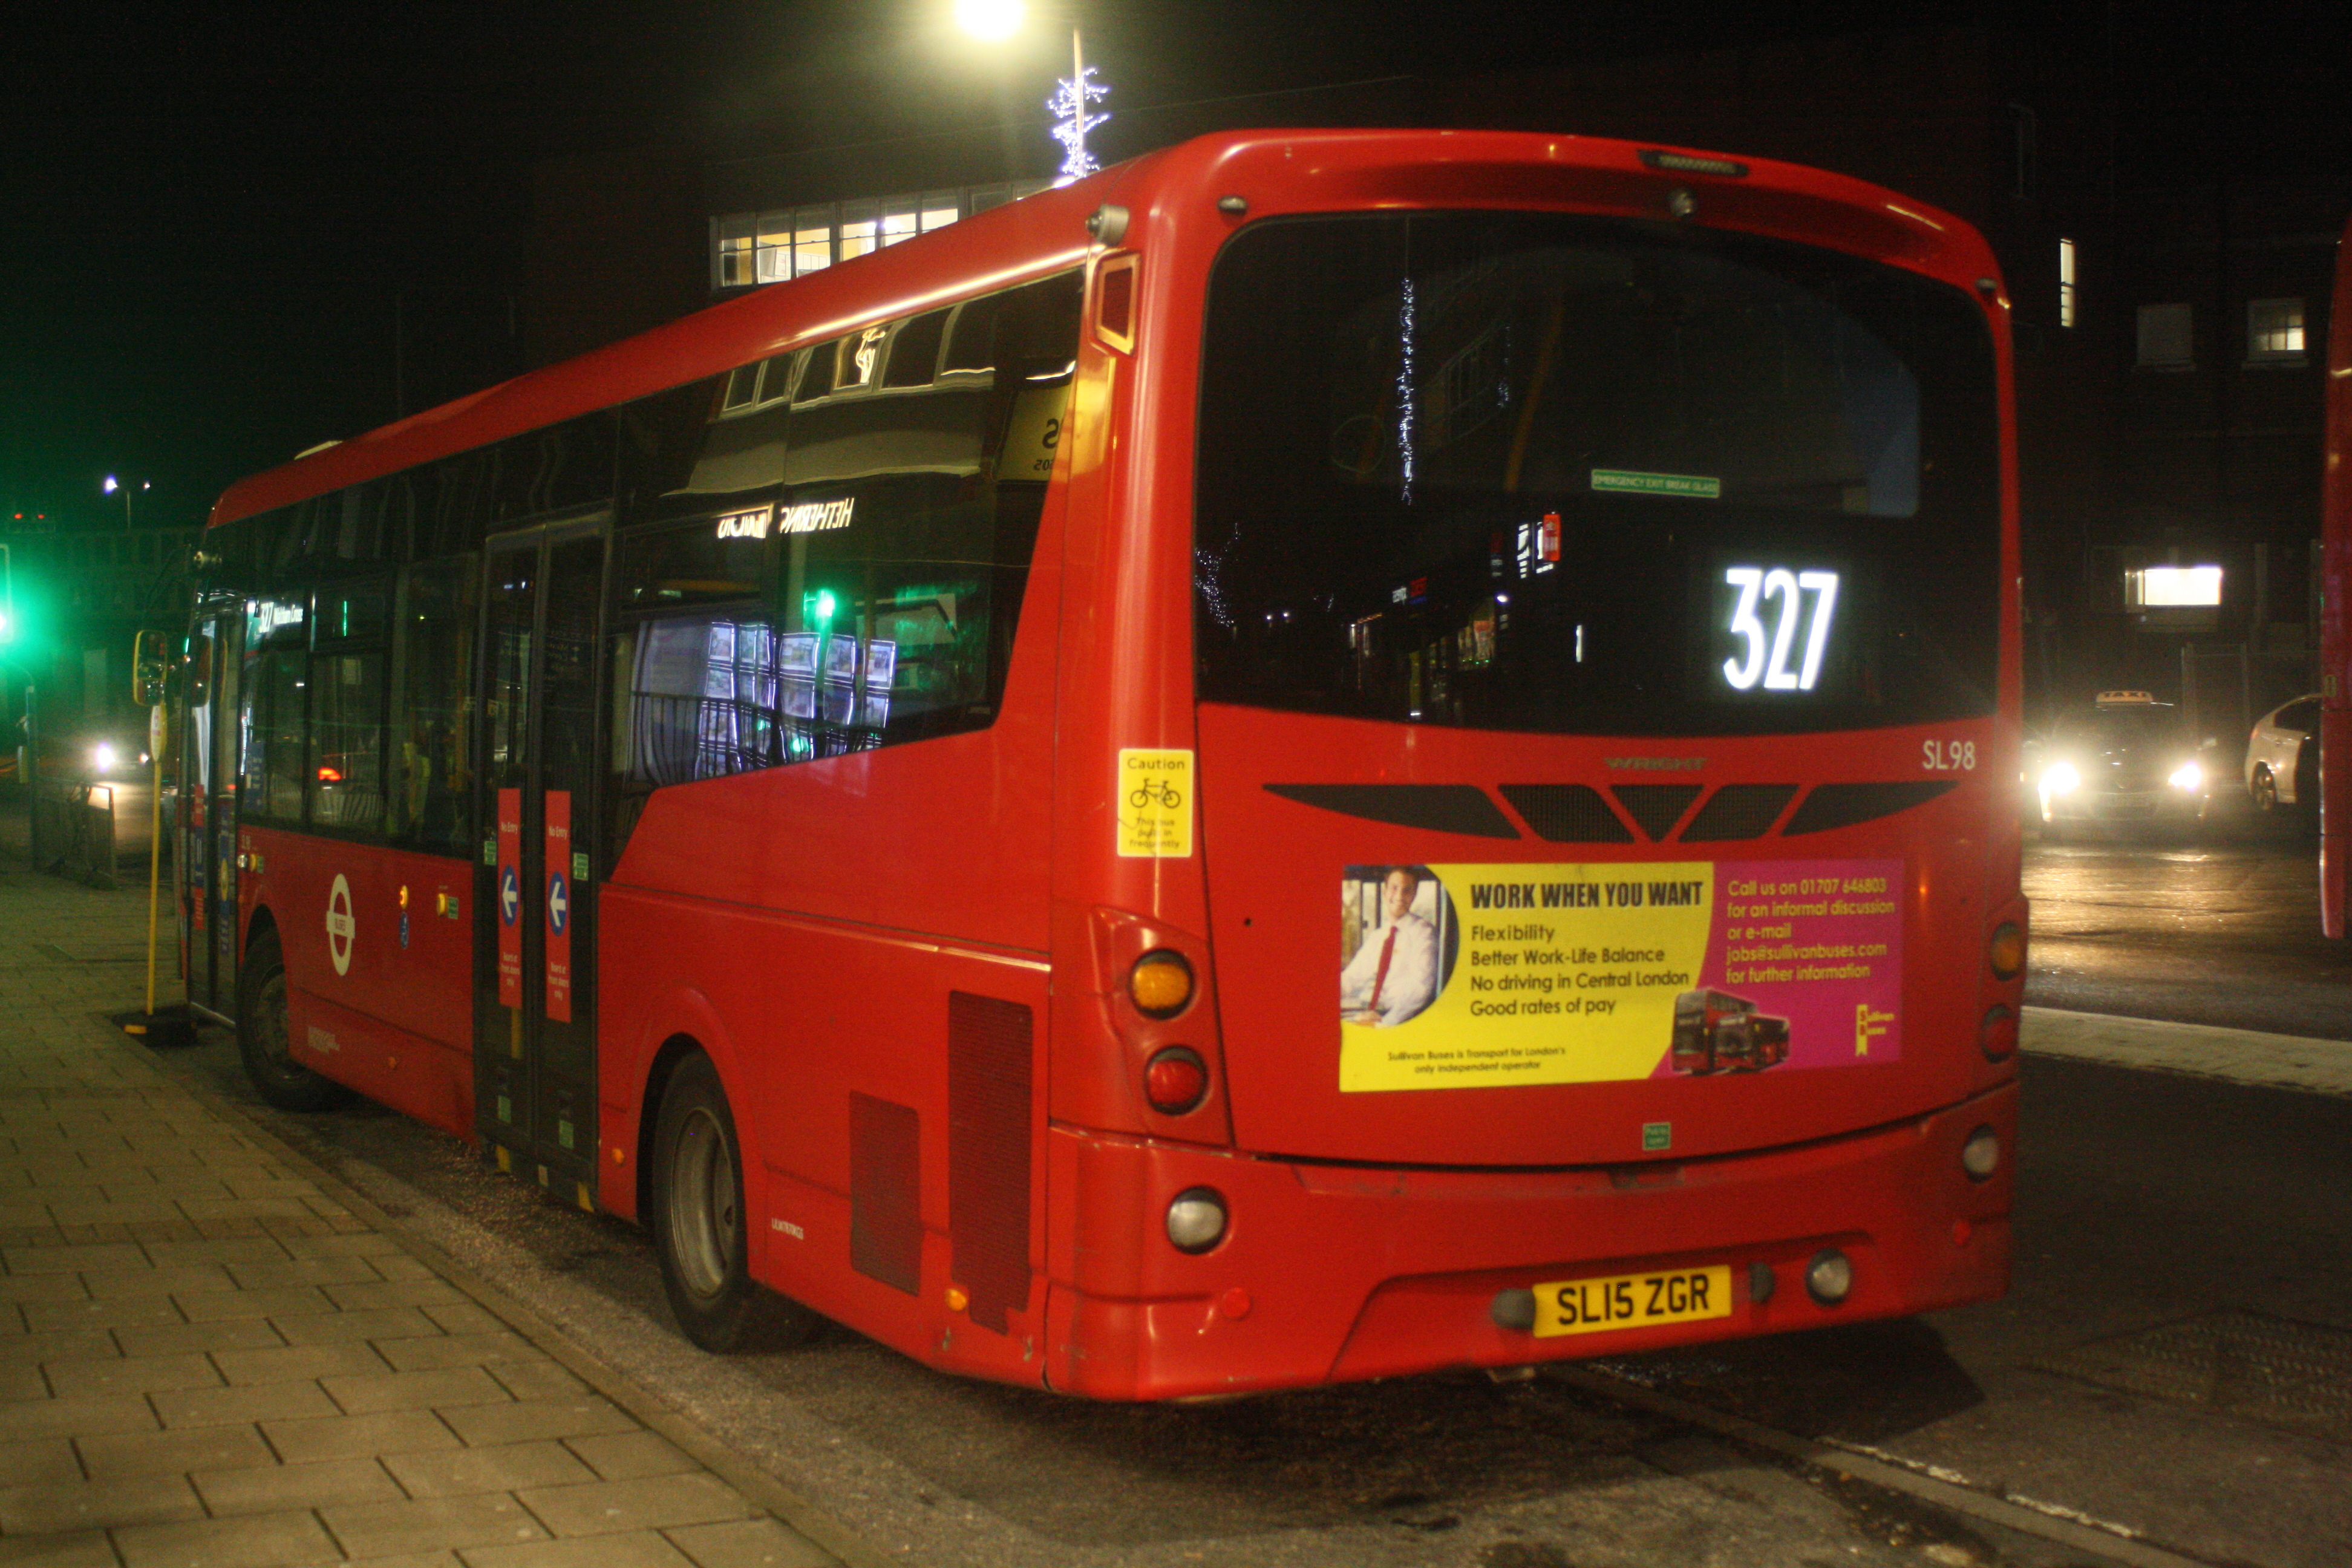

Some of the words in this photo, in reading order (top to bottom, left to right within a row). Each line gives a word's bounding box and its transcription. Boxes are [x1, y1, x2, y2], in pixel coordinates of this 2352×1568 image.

[1723, 568, 1838, 690] 327
[1128, 757, 1185, 769] Caution
[1604, 757, 1709, 771] WRIGHT
[1922, 740, 1976, 770] SL98
[1471, 884, 1535, 909] WORK
[1541, 883, 1599, 907] WHEN
[1606, 882, 1642, 907] YOU
[1649, 881, 1704, 906] WANT
[1728, 880, 1757, 896] Call
[1760, 883, 1776, 895] us
[1779, 883, 1797, 895] on
[1800, 878, 1839, 894] 01707
[1727, 902, 1745, 918] for
[1750, 904, 1769, 917] an
[1772, 900, 1828, 916] informal
[1831, 899, 1895, 915] discussion
[1471, 924, 1555, 943] Flexibility
[1728, 927, 1741, 939] or
[1745, 923, 1792, 939] e-mail
[1471, 949, 1517, 966] Better
[1524, 948, 1595, 964] Work-Life
[1602, 947, 1665, 963] Balance
[1726, 944, 1887, 966] jobs@sullivanbuses.com
[1471, 976, 1494, 991] No
[1498, 975, 1552, 993] driving
[1558, 974, 1571, 988] in
[1576, 972, 1631, 988] Central
[1636, 970, 1689, 986] London
[1726, 968, 1745, 984] for
[1749, 965, 1793, 982] further
[1796, 964, 1870, 981] information
[1471, 1000, 1517, 1016] Good
[1522, 999, 1560, 1014] rates
[1566, 998, 1581, 1013] of
[1586, 999, 1616, 1016] pay
[1428, 1050, 1454, 1060] Buses
[1457, 1050, 1463, 1059] is
[1466, 1048, 1508, 1060] Transport
[1511, 1048, 1523, 1057] for
[1525, 1047, 1566, 1057] London's
[1414, 1063, 1434, 1074] only
[1437, 1062, 1499, 1074] independent
[1501, 1060, 1541, 1072] operator
[1557, 1281, 1633, 1326] SL15
[1645, 1273, 1709, 1317] ZGR
